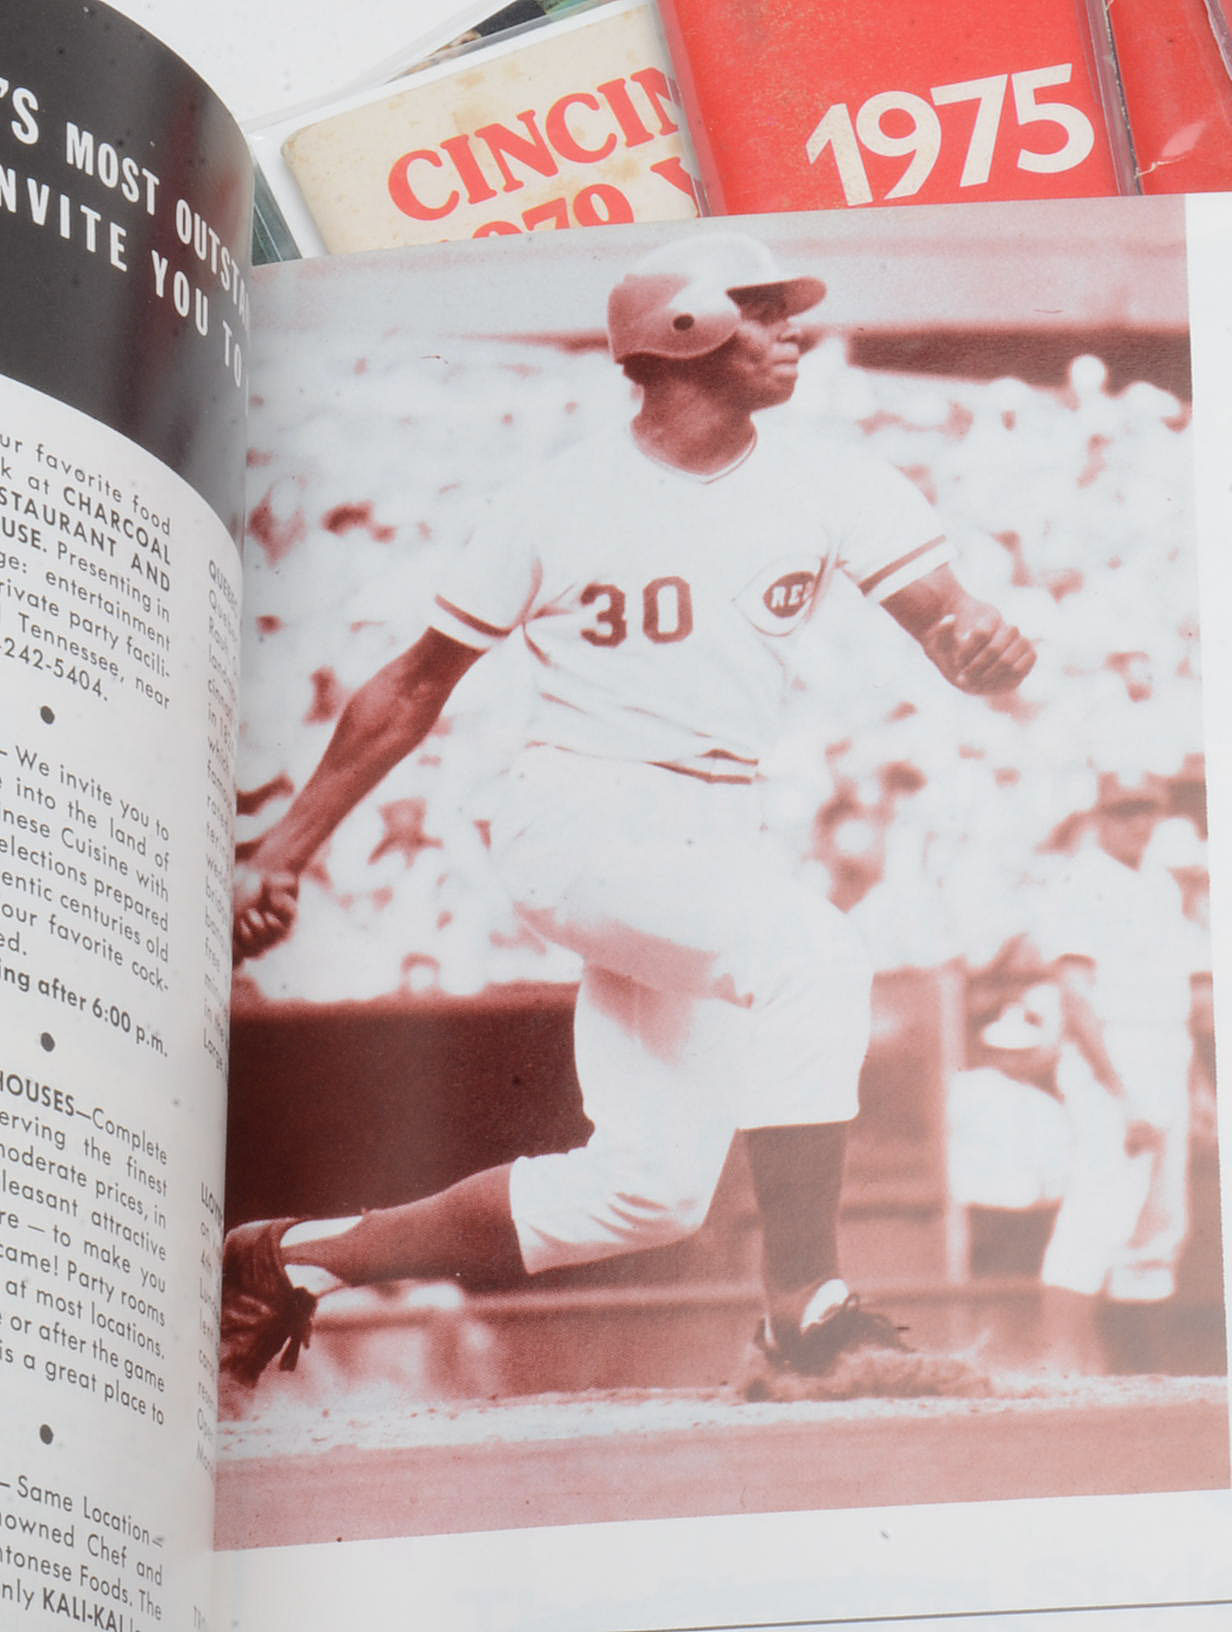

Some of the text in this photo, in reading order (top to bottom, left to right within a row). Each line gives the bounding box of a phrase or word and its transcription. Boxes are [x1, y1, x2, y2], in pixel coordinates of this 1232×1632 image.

[805, 63, 1095, 207] 1975
[66, 121, 160, 216] MOST
[176, 199, 248, 331] OUTSTA
[152, 250, 208, 337] YOU
[223, 320, 242, 388] TO
[28, 475, 171, 565] at CHARCOAL
[36, 443, 170, 536] favorite food
[58, 541, 169, 623] Presenting in
[131, 554, 170, 592] AND
[46, 571, 170, 651] entertainment
[70, 611, 119, 650] party
[580, 576, 693, 648] 30
[18, 612, 170, 709] Tennessee, near
[15, 745, 169, 841] We invite you to
[16, 777, 169, 872] into the land of
[61, 827, 168, 901] Cuisine with
[49, 914, 123, 966] favorite
[60, 894, 168, 963] centuries old
[94, 878, 168, 932] prepared
[38, 978, 168, 1057] after 6:00 p.m.
[84, 1136, 166, 1197] the finest
[91, 1210, 166, 1261] attractive
[96, 1179, 166, 1229] prices, in
[53, 1224, 166, 1293] to make you
[67, 1260, 166, 1328] Party rooms
[6, 1279, 165, 1360] at most locations.
[10, 1315, 165, 1392] or after the game
[23, 1354, 164, 1425] a great place to
[17, 1475, 73, 1512] Same
[80, 1564, 133, 1607] Foods.
[138, 1589, 162, 1621] The
[88, 1533, 163, 1587] Chef and
